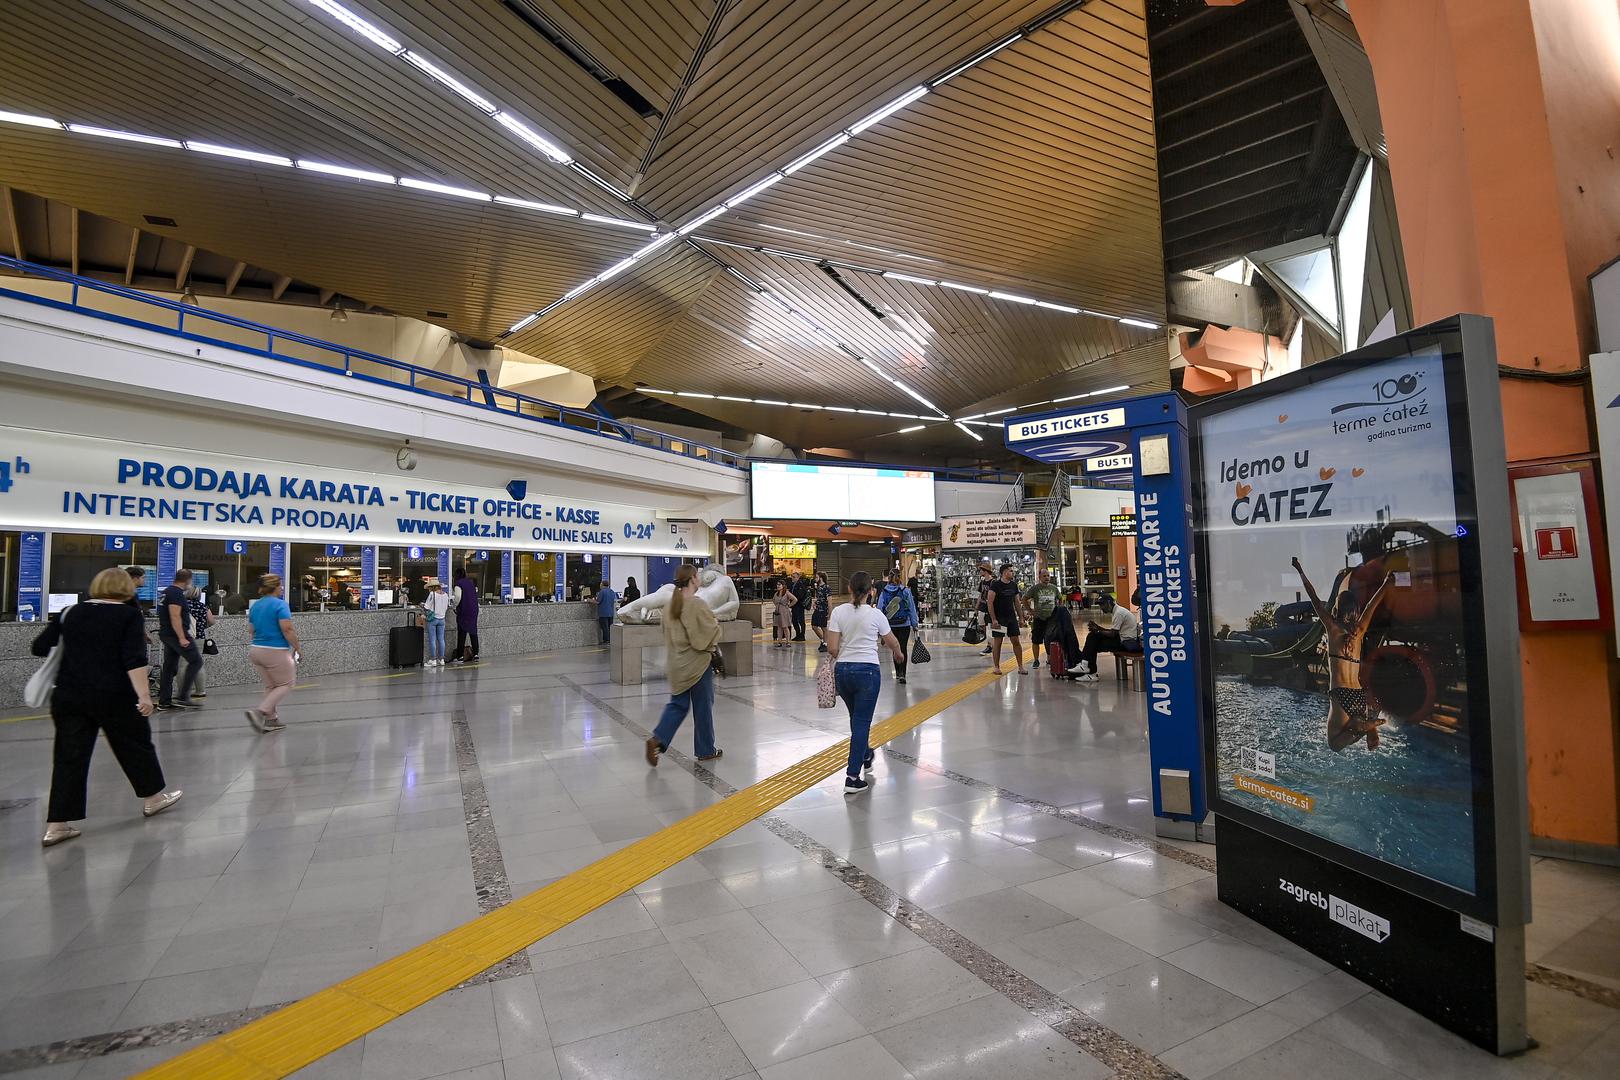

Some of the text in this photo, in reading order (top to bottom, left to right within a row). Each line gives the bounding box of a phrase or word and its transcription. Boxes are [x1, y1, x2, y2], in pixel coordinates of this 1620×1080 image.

[1021, 413, 1109, 437] BUS TICKETS
[1333, 415, 1377, 435] terme
[1367, 422, 1432, 443] godina turizma
[1097, 457, 1119, 468] BUS
[1220, 450, 1309, 484] Idemo u
[118, 458, 272, 500] PRODAJA
[280, 476, 385, 507] KARATA
[406, 489, 479, 515] TICKET
[483, 499, 542, 520] OFFICE
[556, 506, 600, 526] KASSE
[63, 491, 369, 533] INTERNETSKA PRODAJA
[397, 518, 515, 539] www.akz.hr
[532, 527, 613, 545] ONLINE SALES
[114, 537, 125, 549] 5
[232, 541, 243, 553] 6
[332, 545, 340, 555] 7
[411, 548, 421, 559] 8
[481, 551, 487, 560] 9
[536, 552, 545, 561] 10
[1140, 492, 1172, 716] AUTOBUSNE KARTE
[1165, 544, 1187, 661] BUS TICKETS
[1239, 776, 1309, 810] terme-catez.si
[1279, 877, 1382, 937] zagreb plakat
